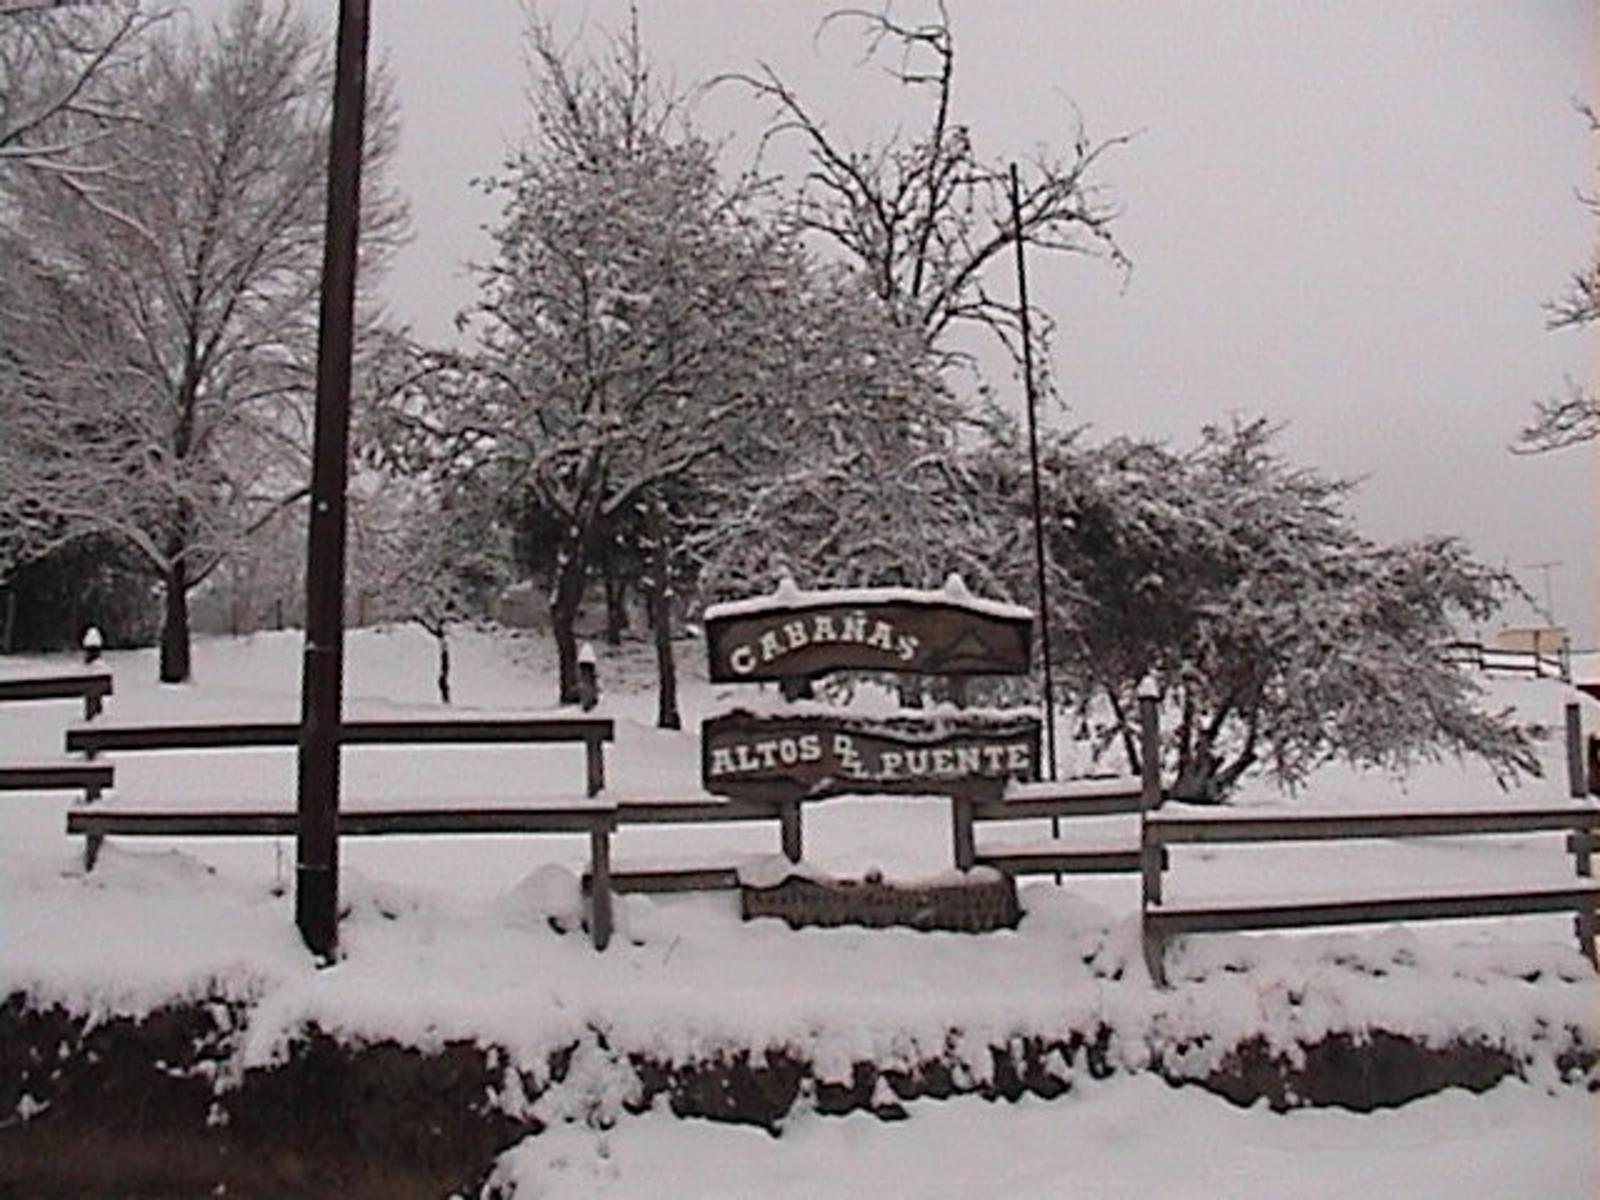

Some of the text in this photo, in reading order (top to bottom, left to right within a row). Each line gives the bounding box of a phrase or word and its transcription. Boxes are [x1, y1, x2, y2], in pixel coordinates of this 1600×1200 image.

[730, 611, 919, 674] CABAÑAS
[712, 735, 821, 775] ALTOS
[879, 744, 1029, 779] PUENTE
